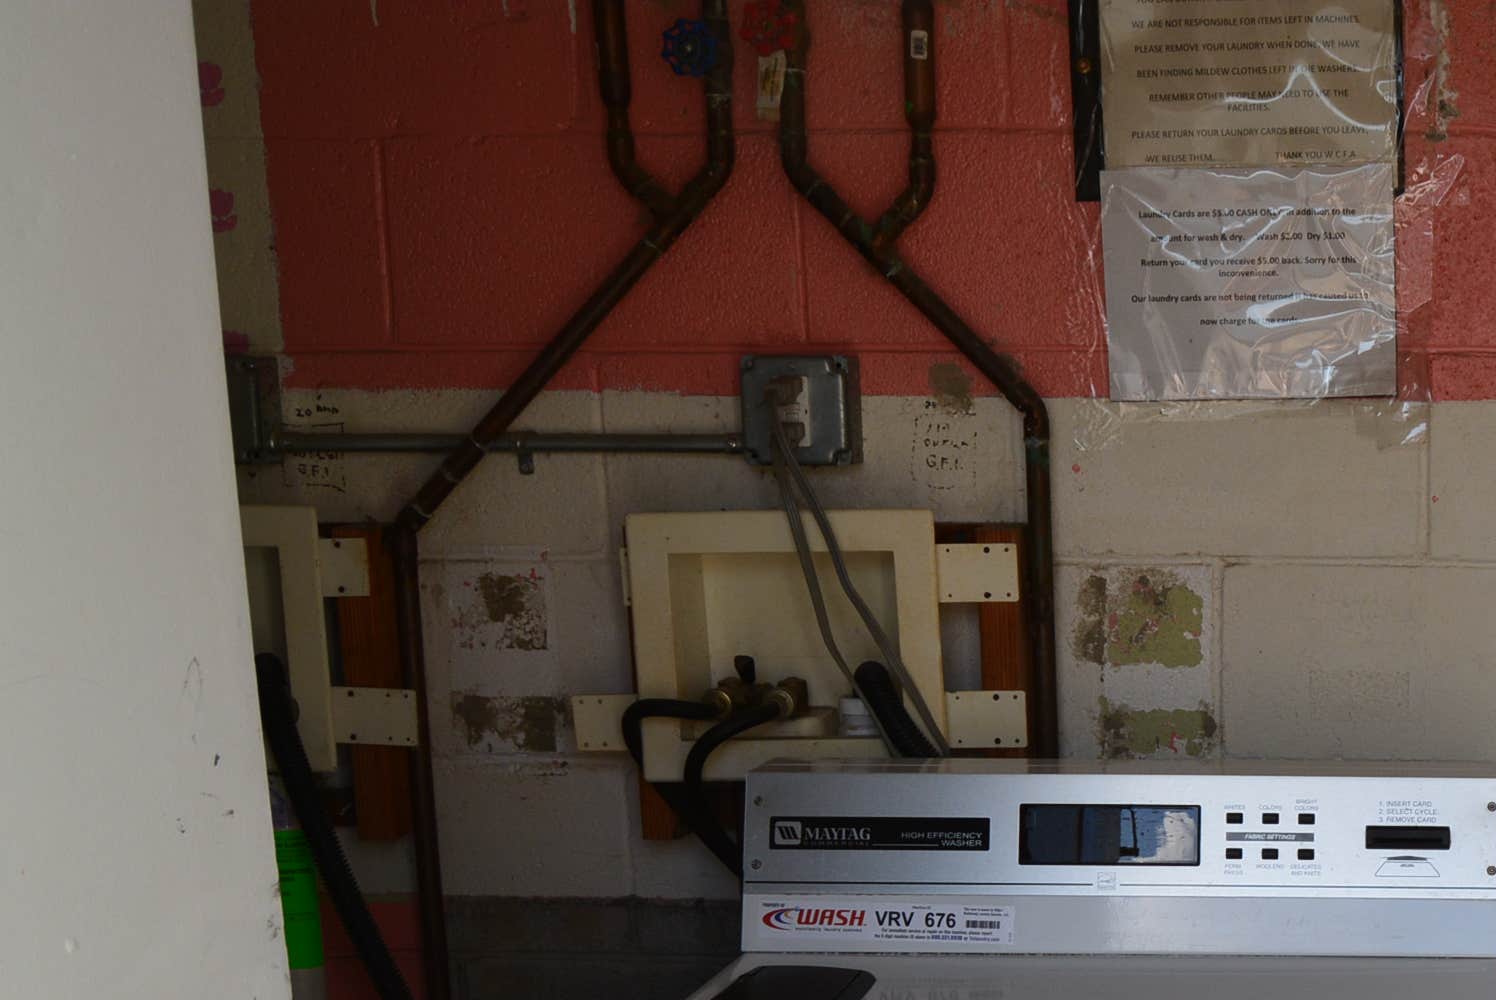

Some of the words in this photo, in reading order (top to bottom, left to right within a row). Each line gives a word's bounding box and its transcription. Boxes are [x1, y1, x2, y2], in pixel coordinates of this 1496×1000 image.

[1147, 20, 1162, 28] ARE
[1165, 19, 1182, 28] NOT
[1184, 17, 1238, 27] RESPONSIBLE
[1239, 17, 1256, 26] FOR
[1257, 16, 1283, 25] ITEMS
[1284, 16, 1302, 24] LEFT
[1304, 16, 1313, 24] IN
[1134, 44, 1162, 54] PLEASE
[1165, 44, 1199, 53] REMOVE
[1202, 43, 1225, 52] YOUR
[1226, 42, 1265, 51] LAUNDRY
[1267, 41, 1293, 49] WHEN
[1323, 40, 1336, 48] WE
[1338, 40, 1360, 48] HAVE
[1136, 69, 1159, 78] BEEN
[1160, 69, 1193, 77] FINDING
[1195, 67, 1229, 76] MILDEW
[1231, 66, 1268, 75] CLOTHES
[1269, 65, 1287, 73] LEFT
[1149, 93, 1195, 102] REMEMBER
[1197, 92, 1225, 101] OTHER
[1258, 90, 1277, 99] MAY
[1302, 89, 1314, 97] TO
[1333, 88, 1349, 97] THE
[1131, 130, 1160, 139] PLEASE
[1162, 129, 1194, 138] RETURN
[1197, 128, 1219, 137] YOUR
[1221, 127, 1258, 136] LAUNDRY
[1260, 127, 1287, 136] CARDS
[1289, 126, 1319, 135] BEFORE
[1322, 126, 1340, 135] YOU
[1145, 154, 1159, 163] WE
[1162, 153, 1187, 162] REUSE
[1275, 151, 1302, 160] THANK
[1305, 151, 1322, 159] YOU
[1138, 209, 1170, 219] Laundy
[1172, 209, 1197, 218] Cards
[1236, 207, 1258, 217] CASH
[1332, 207, 1341, 216] to
[1342, 207, 1356, 216] the
[1150, 234, 1183, 242] amunt
[1184, 233, 1197, 242] for
[1198, 233, 1219, 242] wash
[1220, 233, 1227, 242] &
[1307, 231, 1321, 242] Dry
[1323, 231, 1346, 241] $1.00
[1141, 259, 1168, 267] Return
[1170, 260, 1188, 269] you
[1210, 258, 1225, 268] you
[1226, 257, 1255, 266] receive
[1257, 256, 1280, 266] $5.00
[1304, 256, 1326, 266] Sorry
[1327, 255, 1340, 264] for
[1341, 255, 1357, 264] this
[1131, 294, 1147, 303] Our
[1148, 293, 1180, 304] laundry
[1181, 293, 1202, 302] cards
[1219, 293, 1232, 301] not
[1234, 292, 1256, 303] being
[1200, 318, 1218, 326] now
[1219, 317, 1246, 327] charge
[1386, 800, 1411, 808] INSERT
[1412, 800, 1433, 808] CARD
[1414, 808, 1438, 816] CYCLE
[1416, 816, 1437, 824] CARD
[804, 827, 871, 841] MAYTAG
[901, 831, 926, 840] HIGH
[926, 831, 983, 840] EFFICIENCY
[941, 839, 983, 847] WASHER
[797, 909, 866, 926] WASH
[875, 910, 914, 927] VRV
[924, 911, 957, 928] 676
